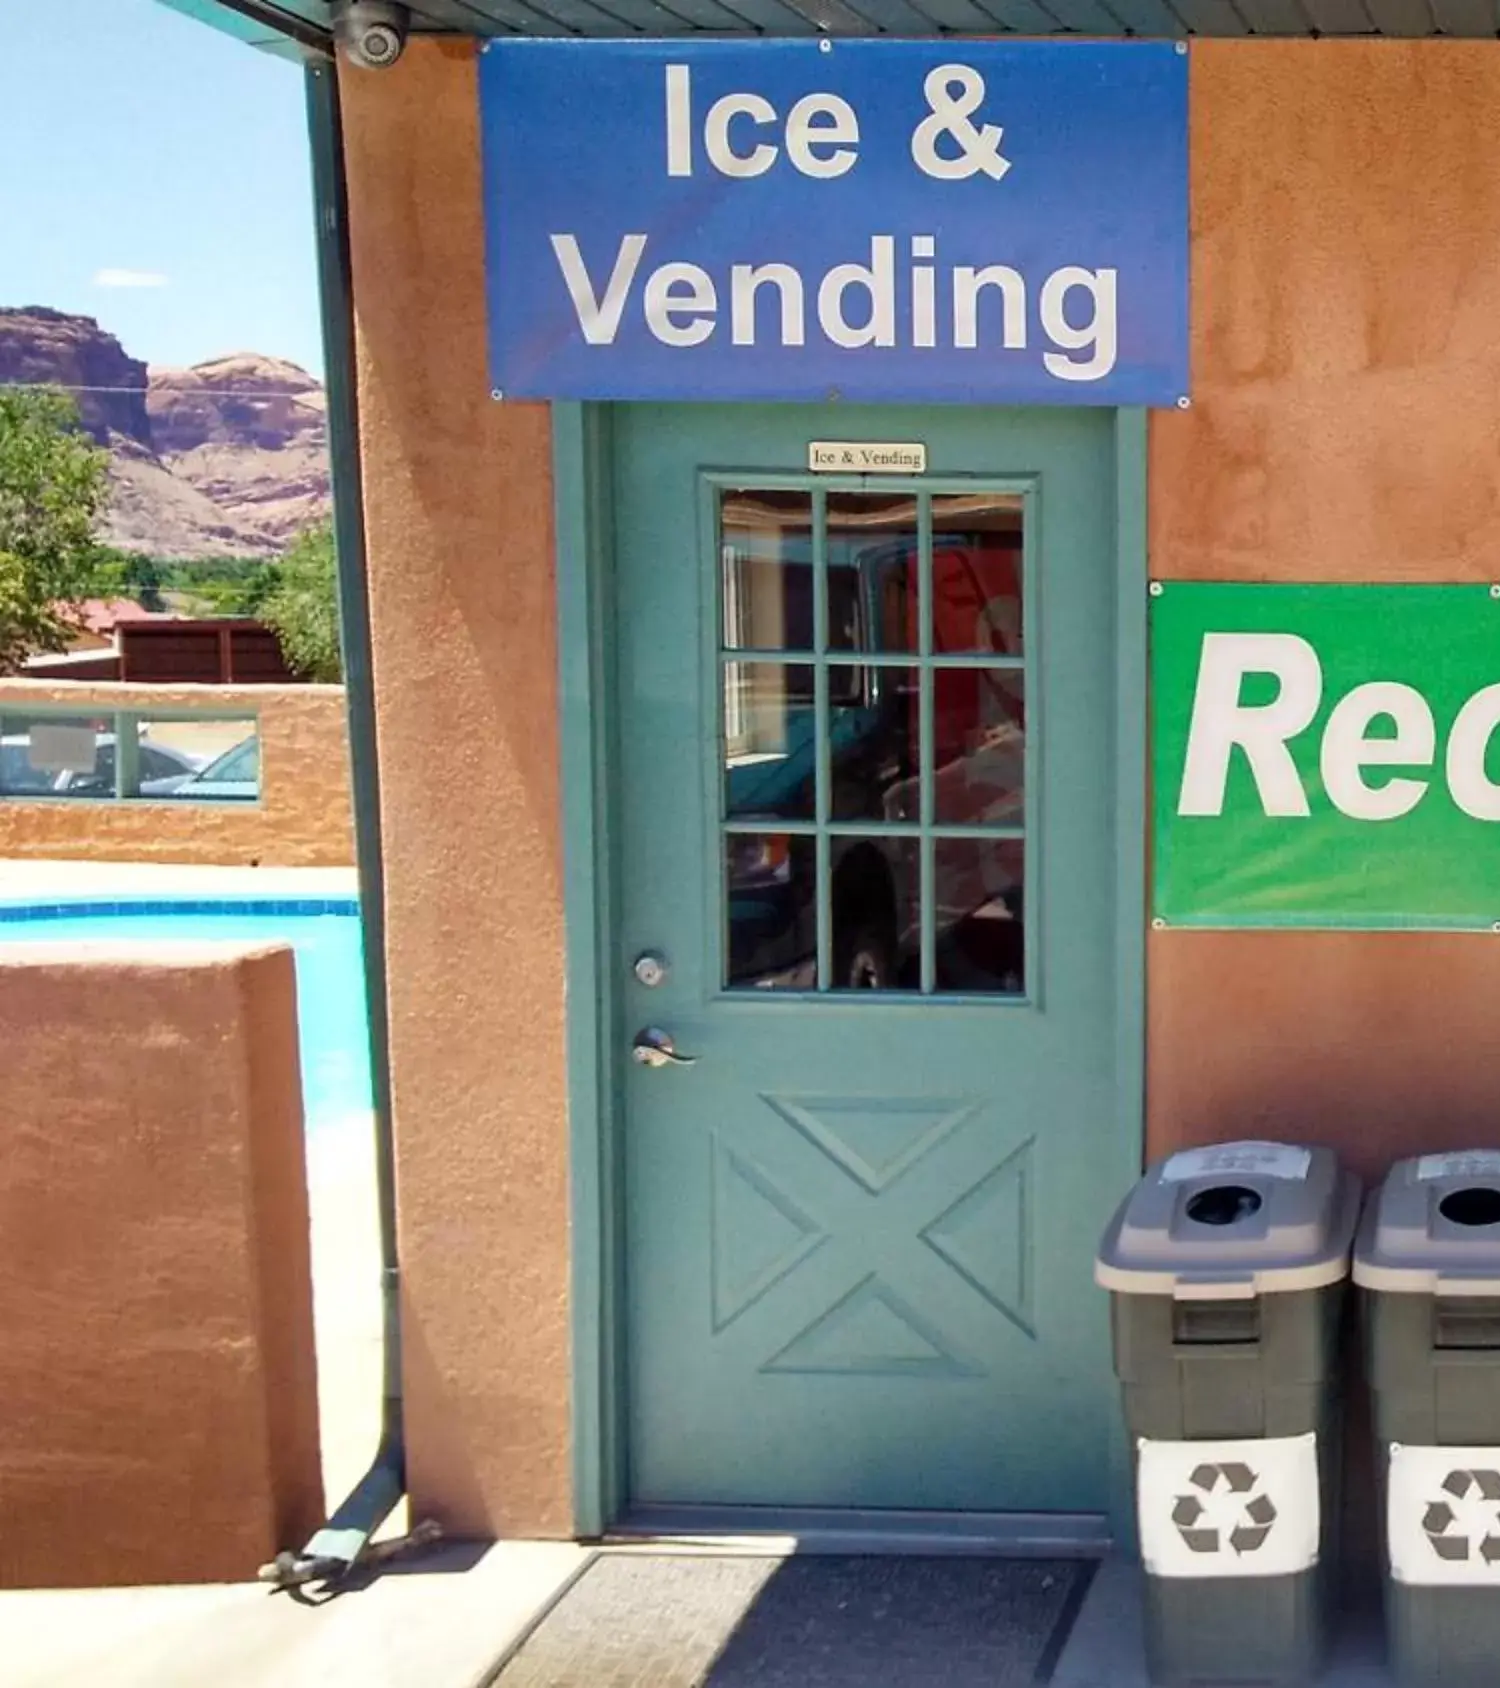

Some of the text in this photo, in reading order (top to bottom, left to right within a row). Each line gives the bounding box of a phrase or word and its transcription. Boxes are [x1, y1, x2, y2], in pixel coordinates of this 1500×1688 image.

[665, 64, 1012, 181] Ice &
[550, 234, 1118, 381] Vending
[815, 449, 921, 468] Ice & Vending
